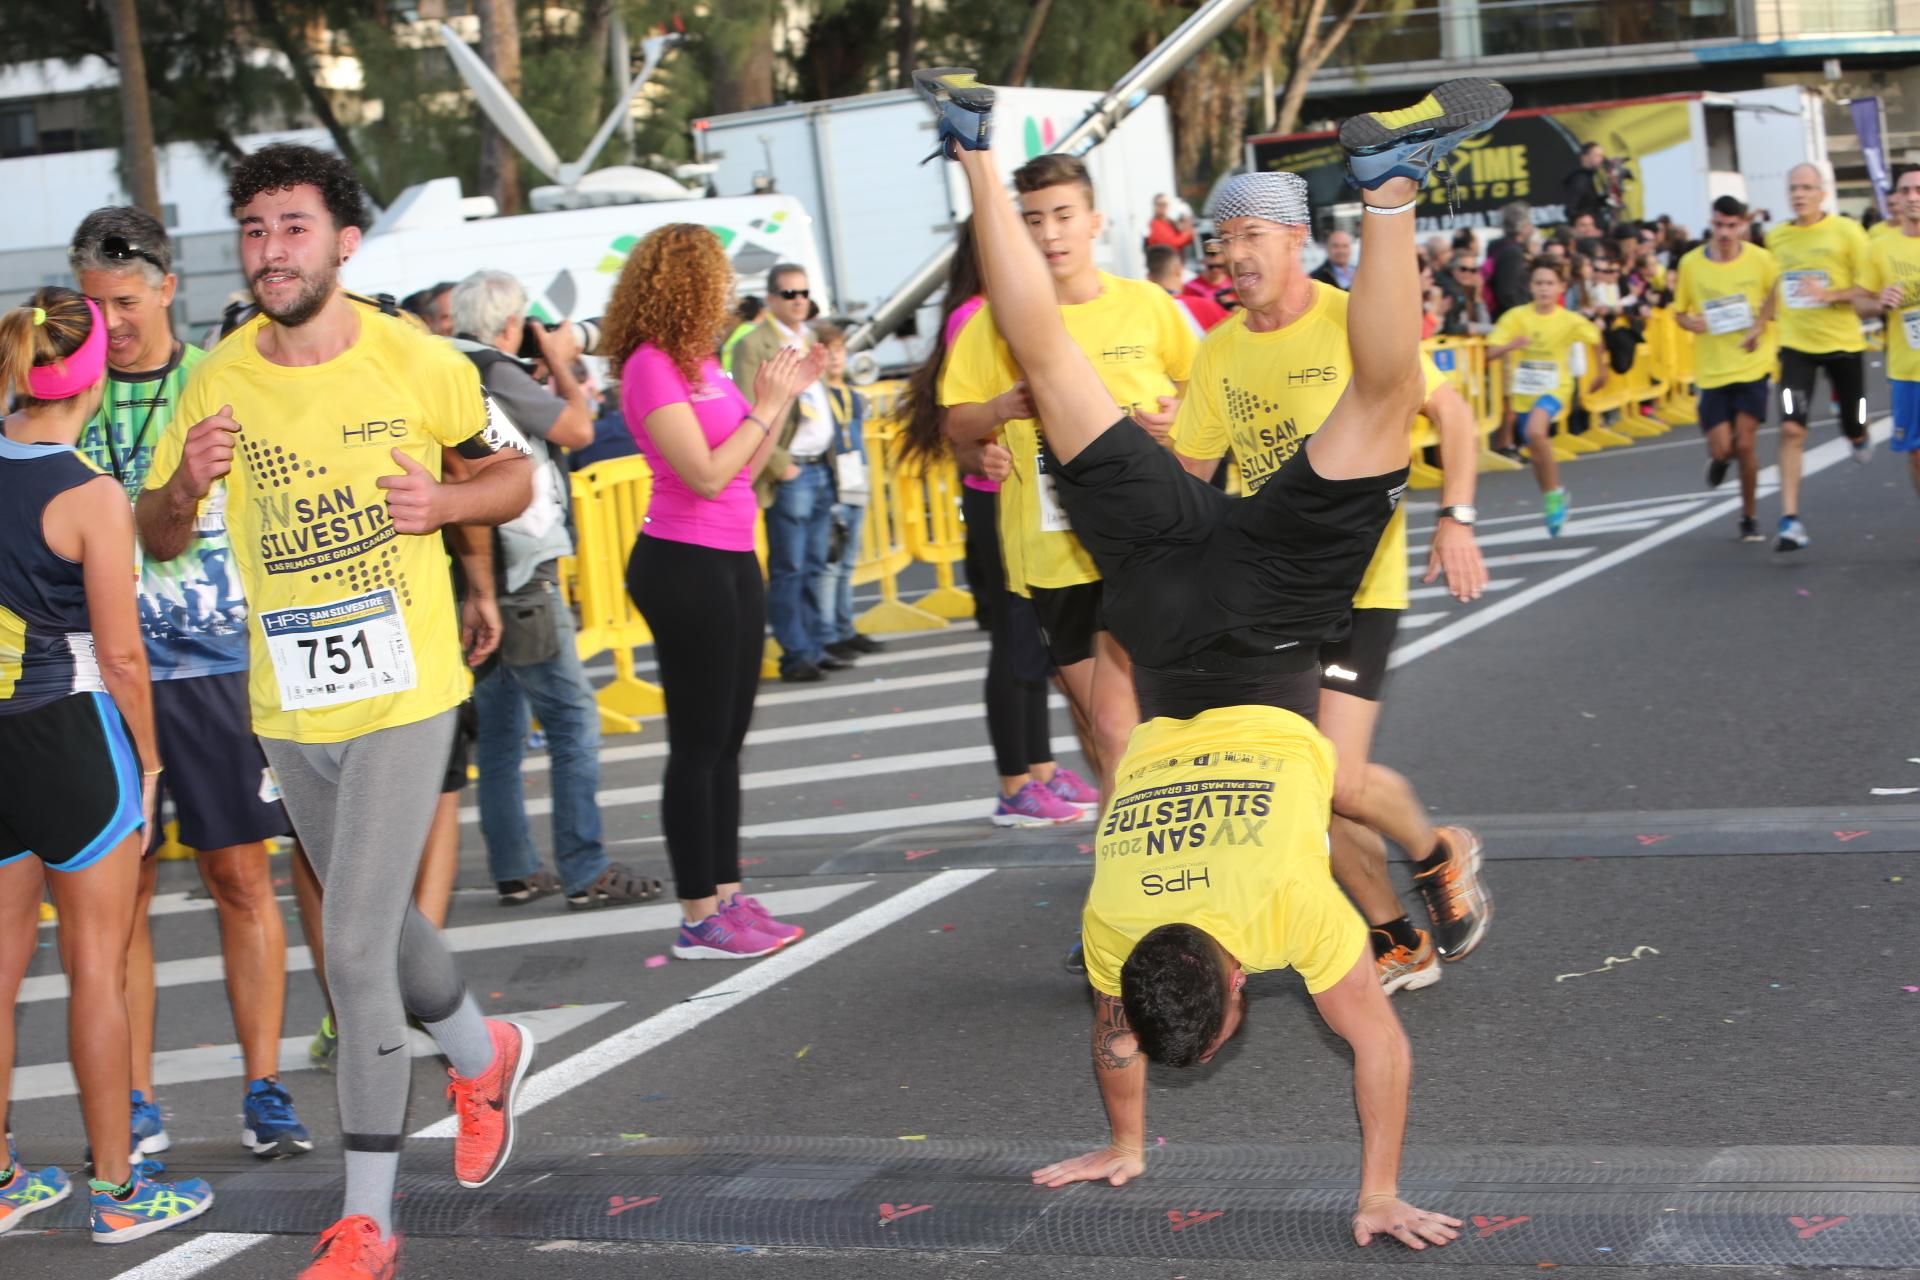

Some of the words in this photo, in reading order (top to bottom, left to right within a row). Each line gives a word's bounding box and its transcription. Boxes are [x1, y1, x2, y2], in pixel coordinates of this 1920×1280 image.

[1102, 345, 1145, 361] HPS
[1287, 366, 1338, 385] HPS
[79, 422, 126, 448] AN
[342, 418, 408, 443] HPS
[1259, 417, 1298, 447] SAN
[295, 485, 355, 523] SAN
[261, 502, 393, 559] SILVESTR
[269, 563, 286, 572] LAS
[317, 552, 332, 562] DE
[332, 545, 361, 560] GRAN
[362, 530, 397, 550] CANARI
[266, 613, 309, 629] HPS
[309, 609, 330, 621] SAN
[329, 596, 384, 617] SILVESTRE
[297, 629, 374, 679] 751
[1153, 785, 1183, 797] GRAN
[1184, 783, 1198, 793] DE
[1201, 781, 1245, 791] PALMAS
[1247, 782, 1270, 790] LAS
[1103, 794, 1272, 837] SILVESTRE
[1146, 823, 1207, 856] SAN
[1209, 818, 1268, 847] XV
[1102, 837, 1142, 861] 2016
[1141, 867, 1210, 896] HPS
